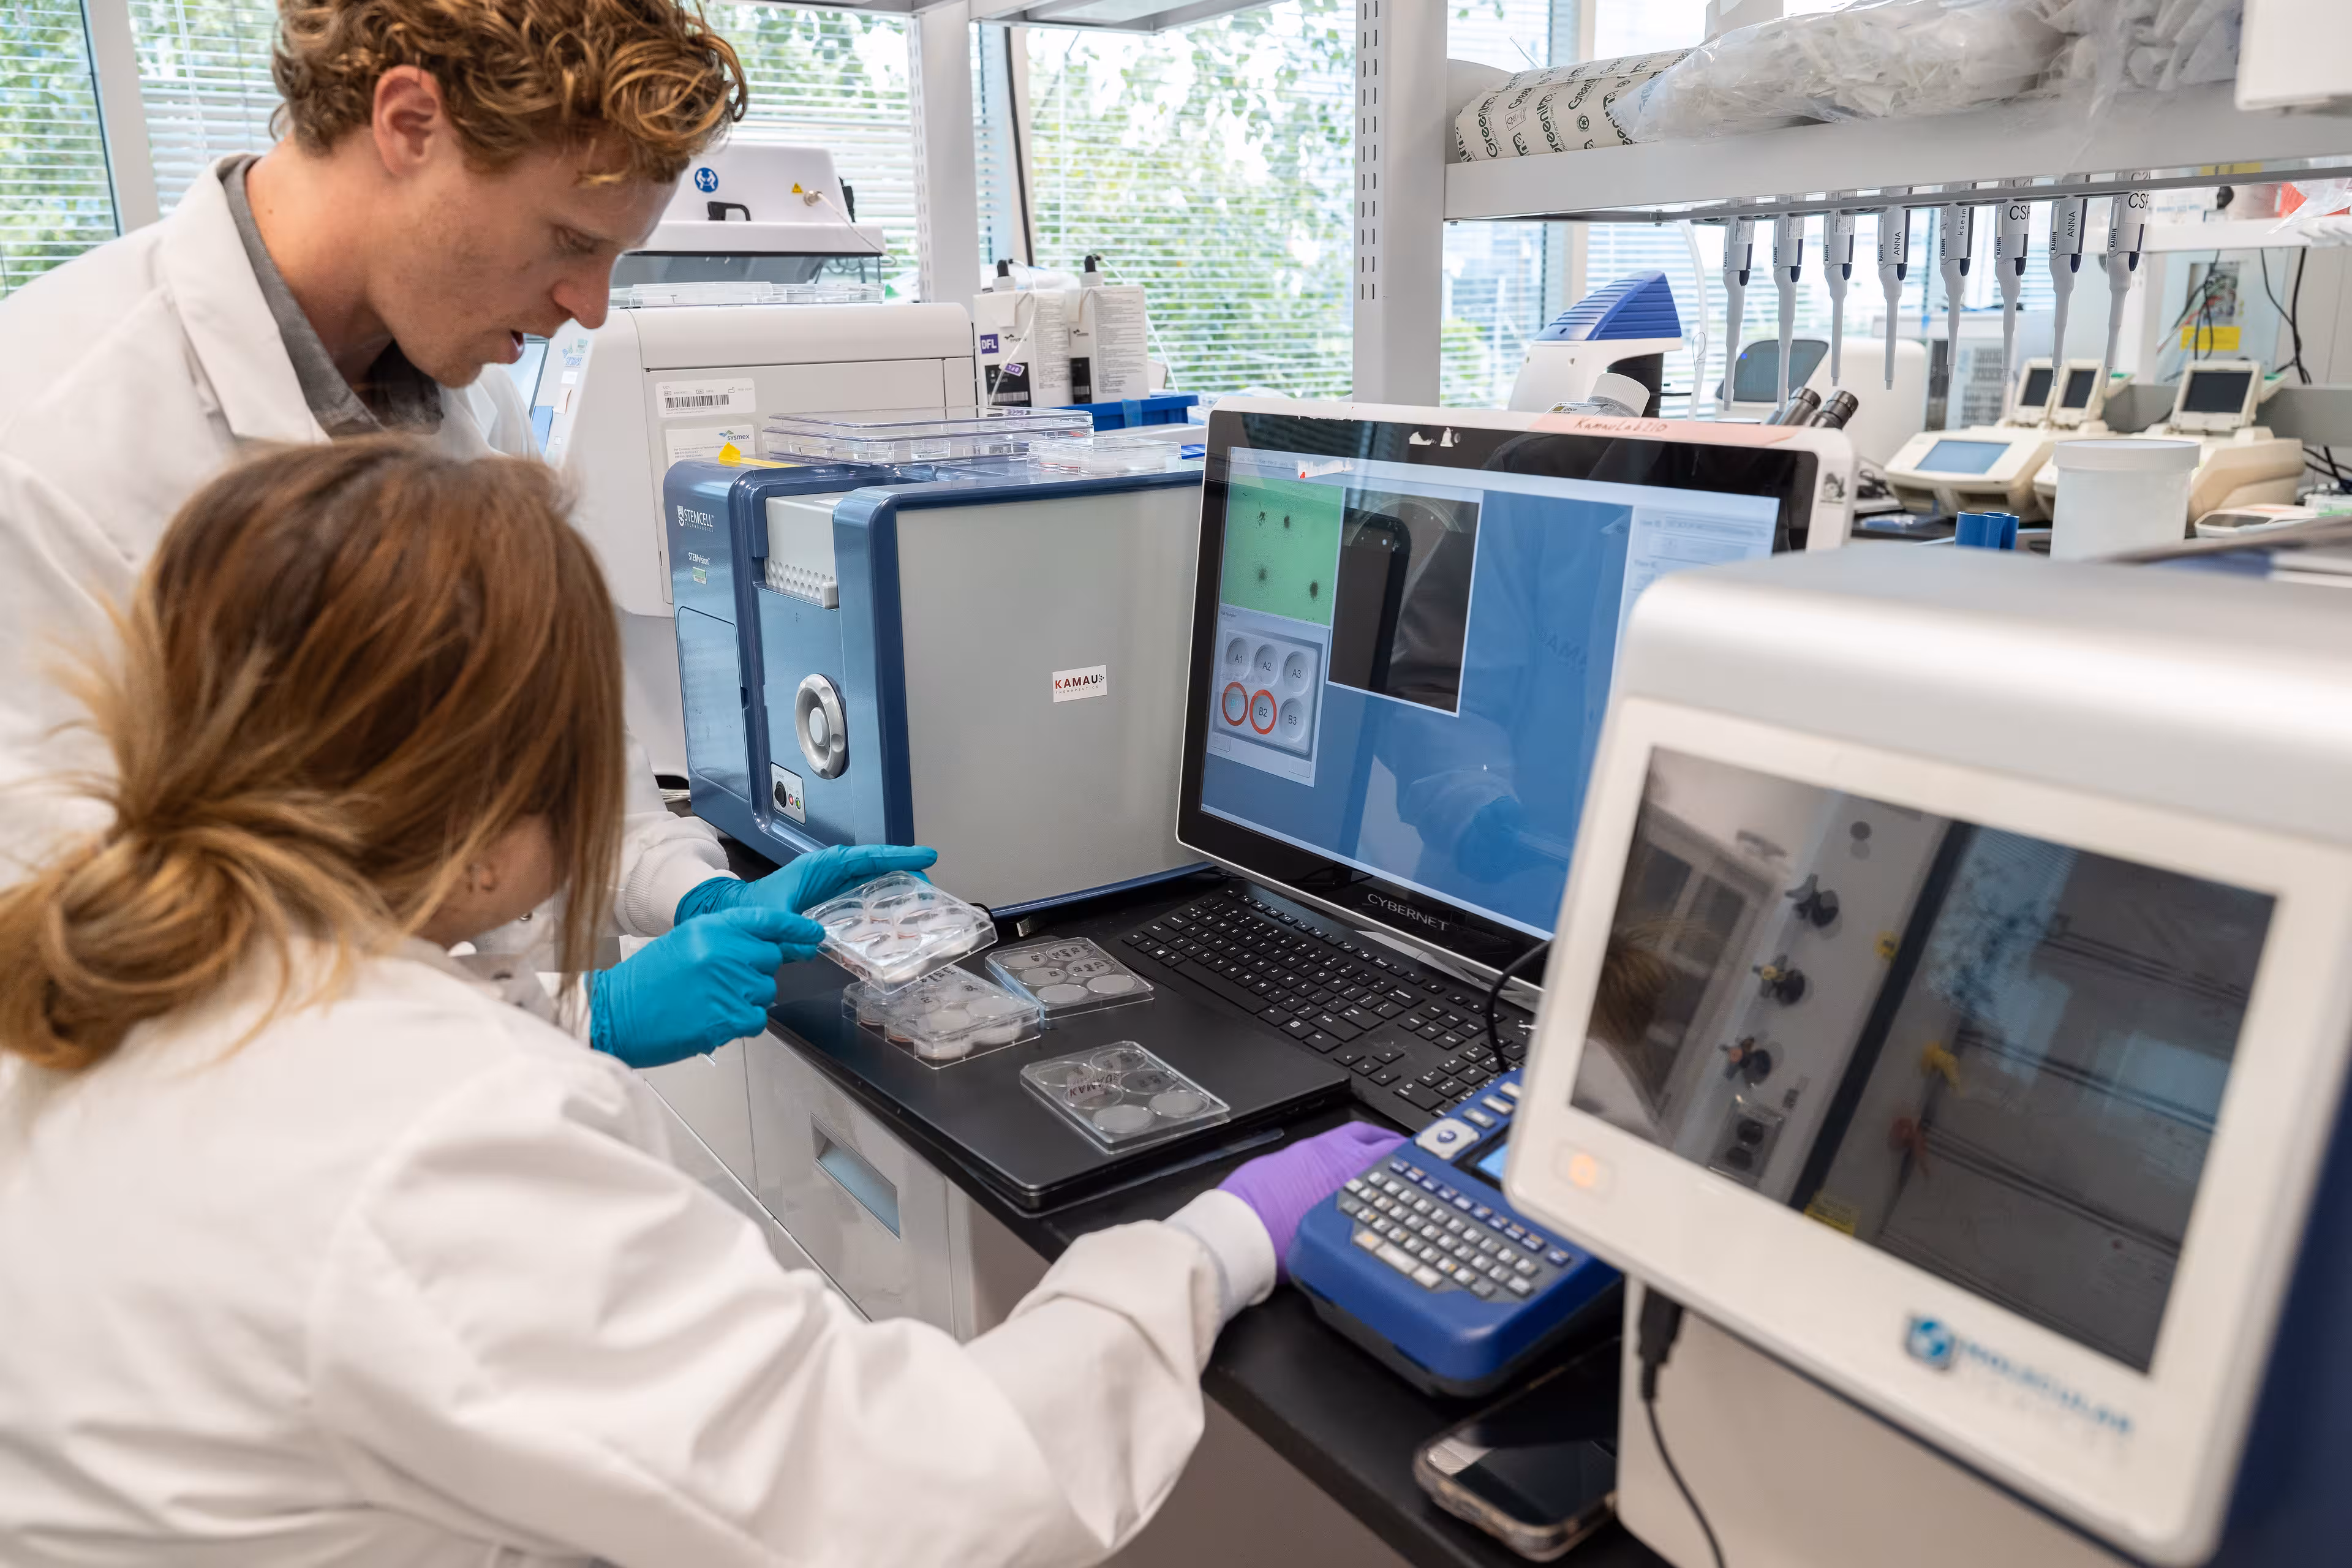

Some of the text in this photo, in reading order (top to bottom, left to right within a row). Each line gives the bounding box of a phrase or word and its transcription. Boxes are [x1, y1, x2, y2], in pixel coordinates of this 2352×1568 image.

[1958, 208, 1967, 236] kseim
[2067, 211, 2076, 237] ANNA
[981, 339, 997, 350] DFL
[685, 522, 714, 533] TECHNOLOGIES
[1234, 654, 1302, 678] A1 A2 A3
[1055, 674, 1098, 689] KAMAU
[1056, 685, 1098, 694] THERAPEUTICS
[1259, 707, 1268, 717] B2
[1288, 715, 1297, 725] B3
[1367, 894, 1449, 931] CYBERNET
